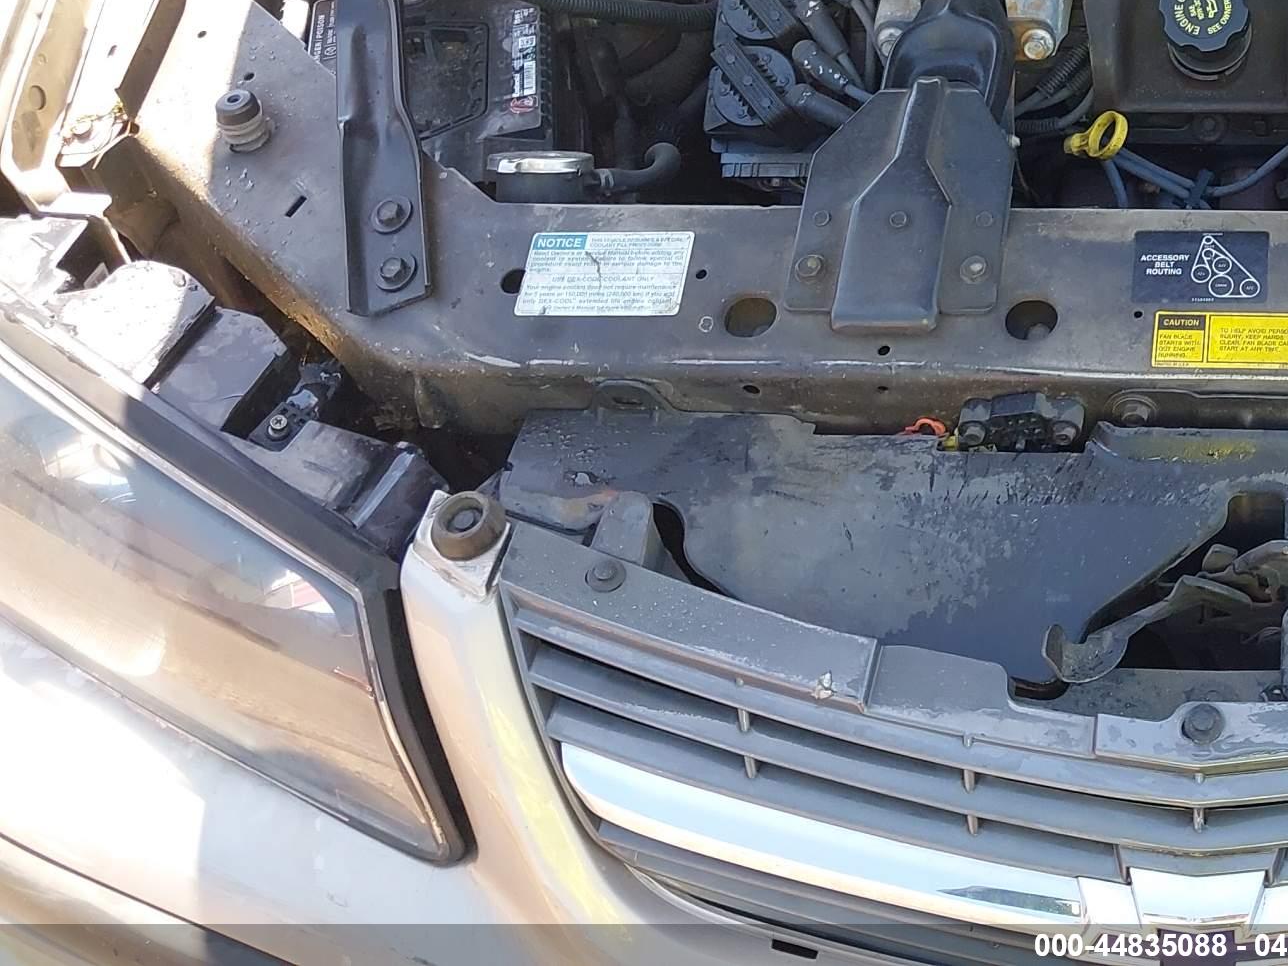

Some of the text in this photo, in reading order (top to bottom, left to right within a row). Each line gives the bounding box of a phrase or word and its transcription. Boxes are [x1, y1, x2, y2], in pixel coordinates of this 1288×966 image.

[1174, 4, 1200, 35] ENGINE
[316, 14, 326, 39] POISON
[1207, 22, 1222, 35] SEE
[537, 238, 582, 248] NOTICE
[1140, 254, 1190, 262] ACCESSORY
